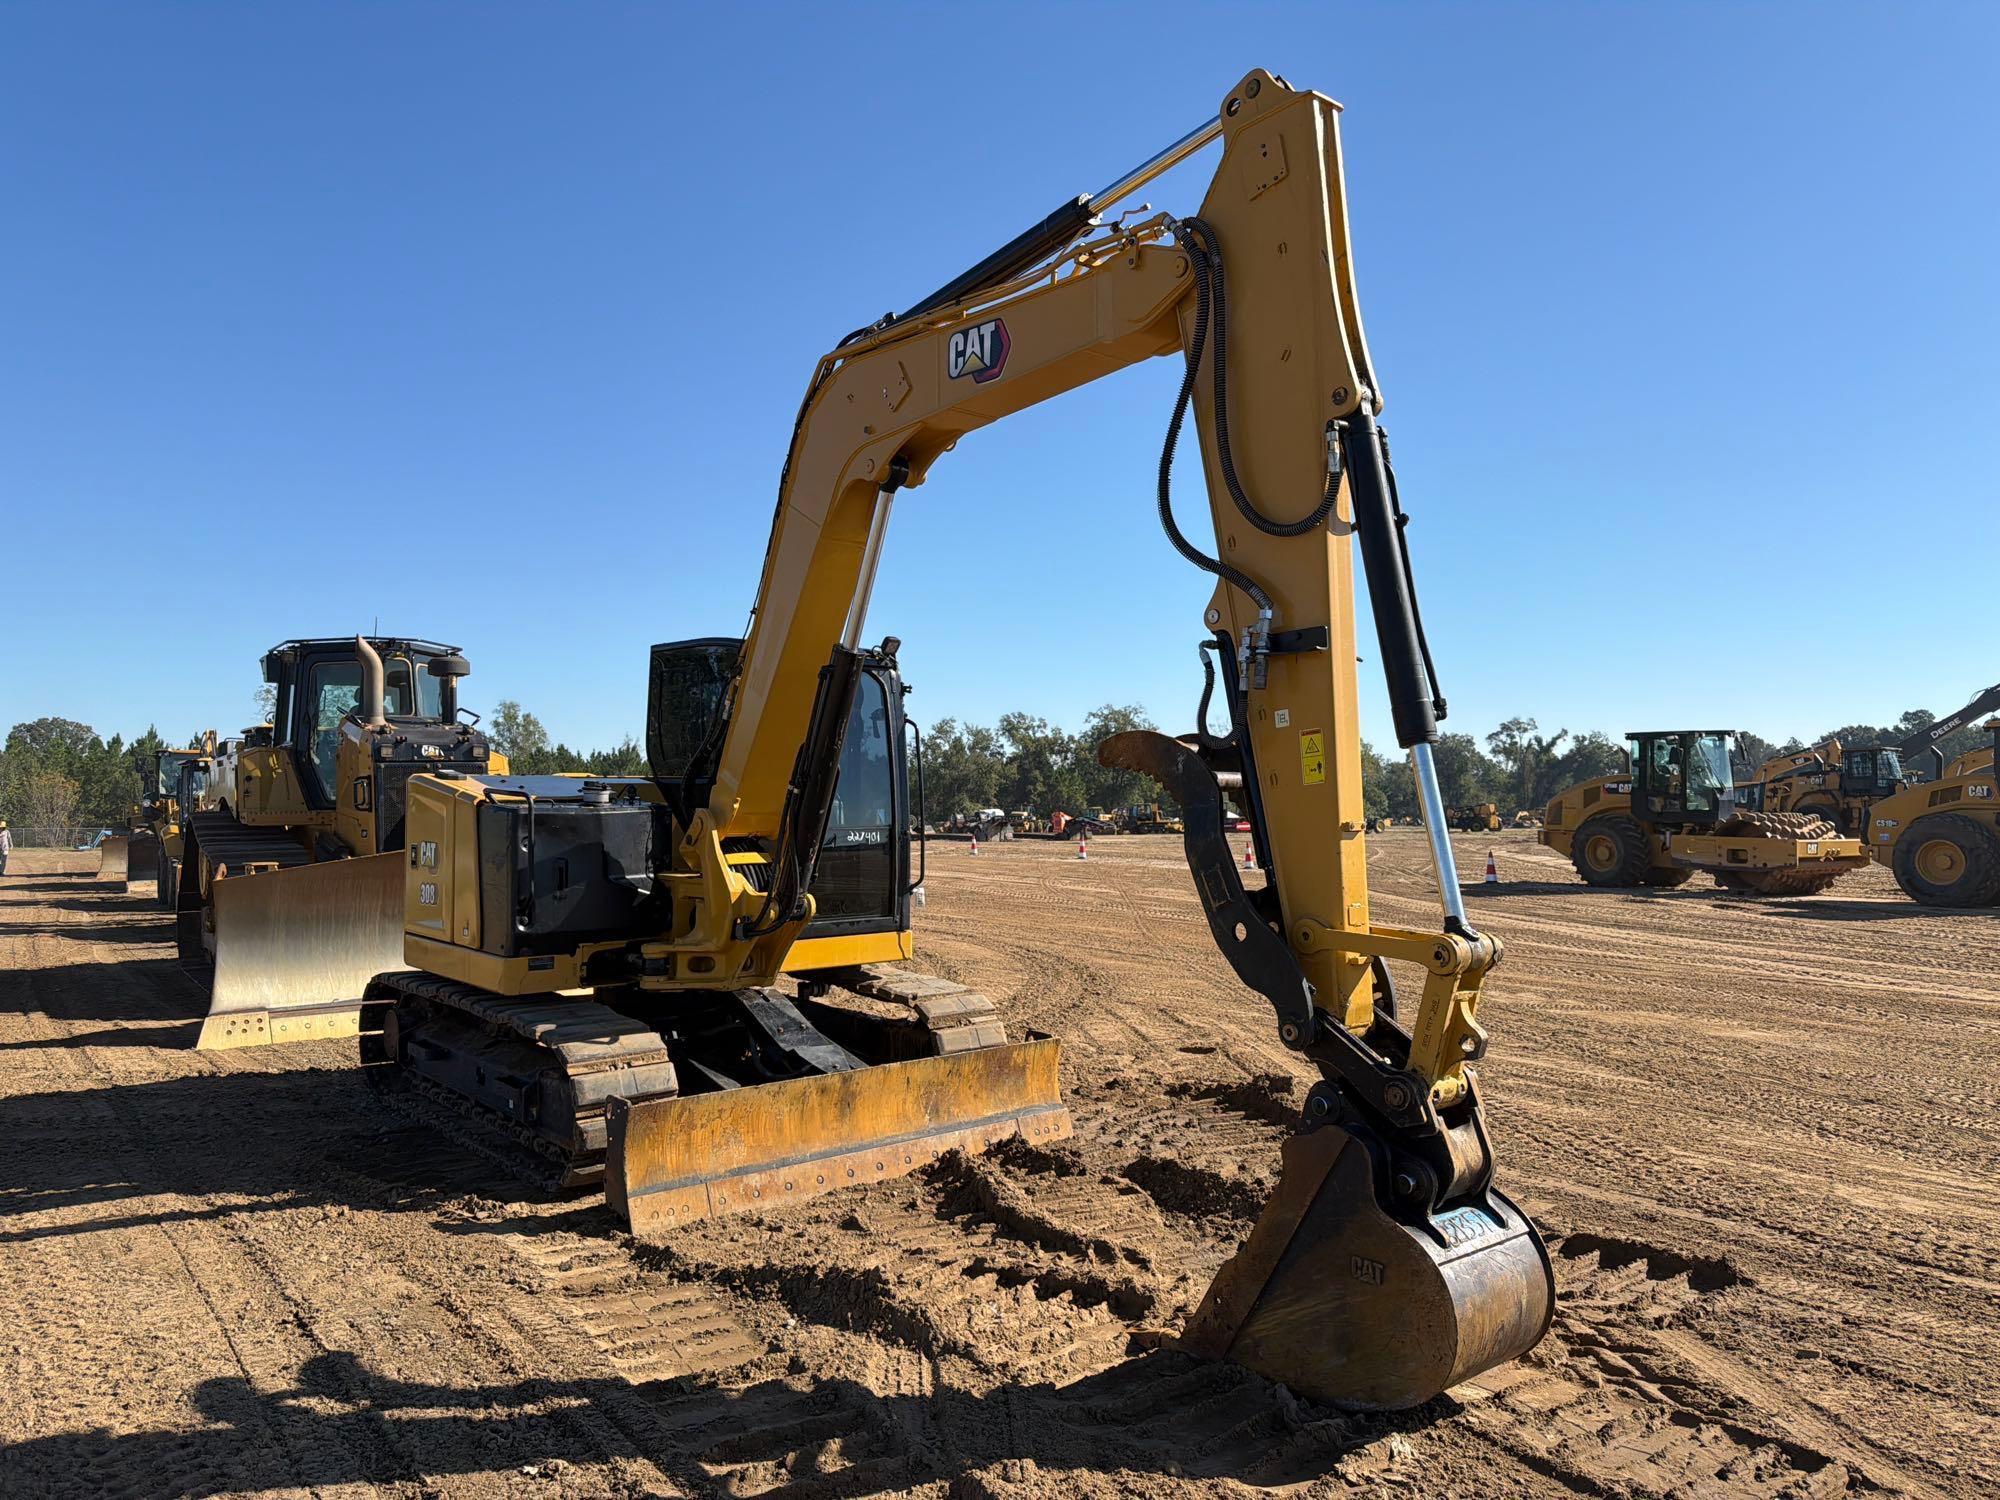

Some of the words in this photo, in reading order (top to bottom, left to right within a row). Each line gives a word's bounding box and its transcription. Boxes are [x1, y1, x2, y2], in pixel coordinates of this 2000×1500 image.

[949, 320, 996, 378] CAT
[1930, 716, 1962, 739] DEERE
[422, 744, 440, 757] CAT
[1968, 785, 1989, 797] CAT
[420, 841, 437, 867] CAT
[1807, 843, 1818, 855] CAT
[420, 884, 436, 904] 308
[1351, 1255, 1384, 1286] CAT
